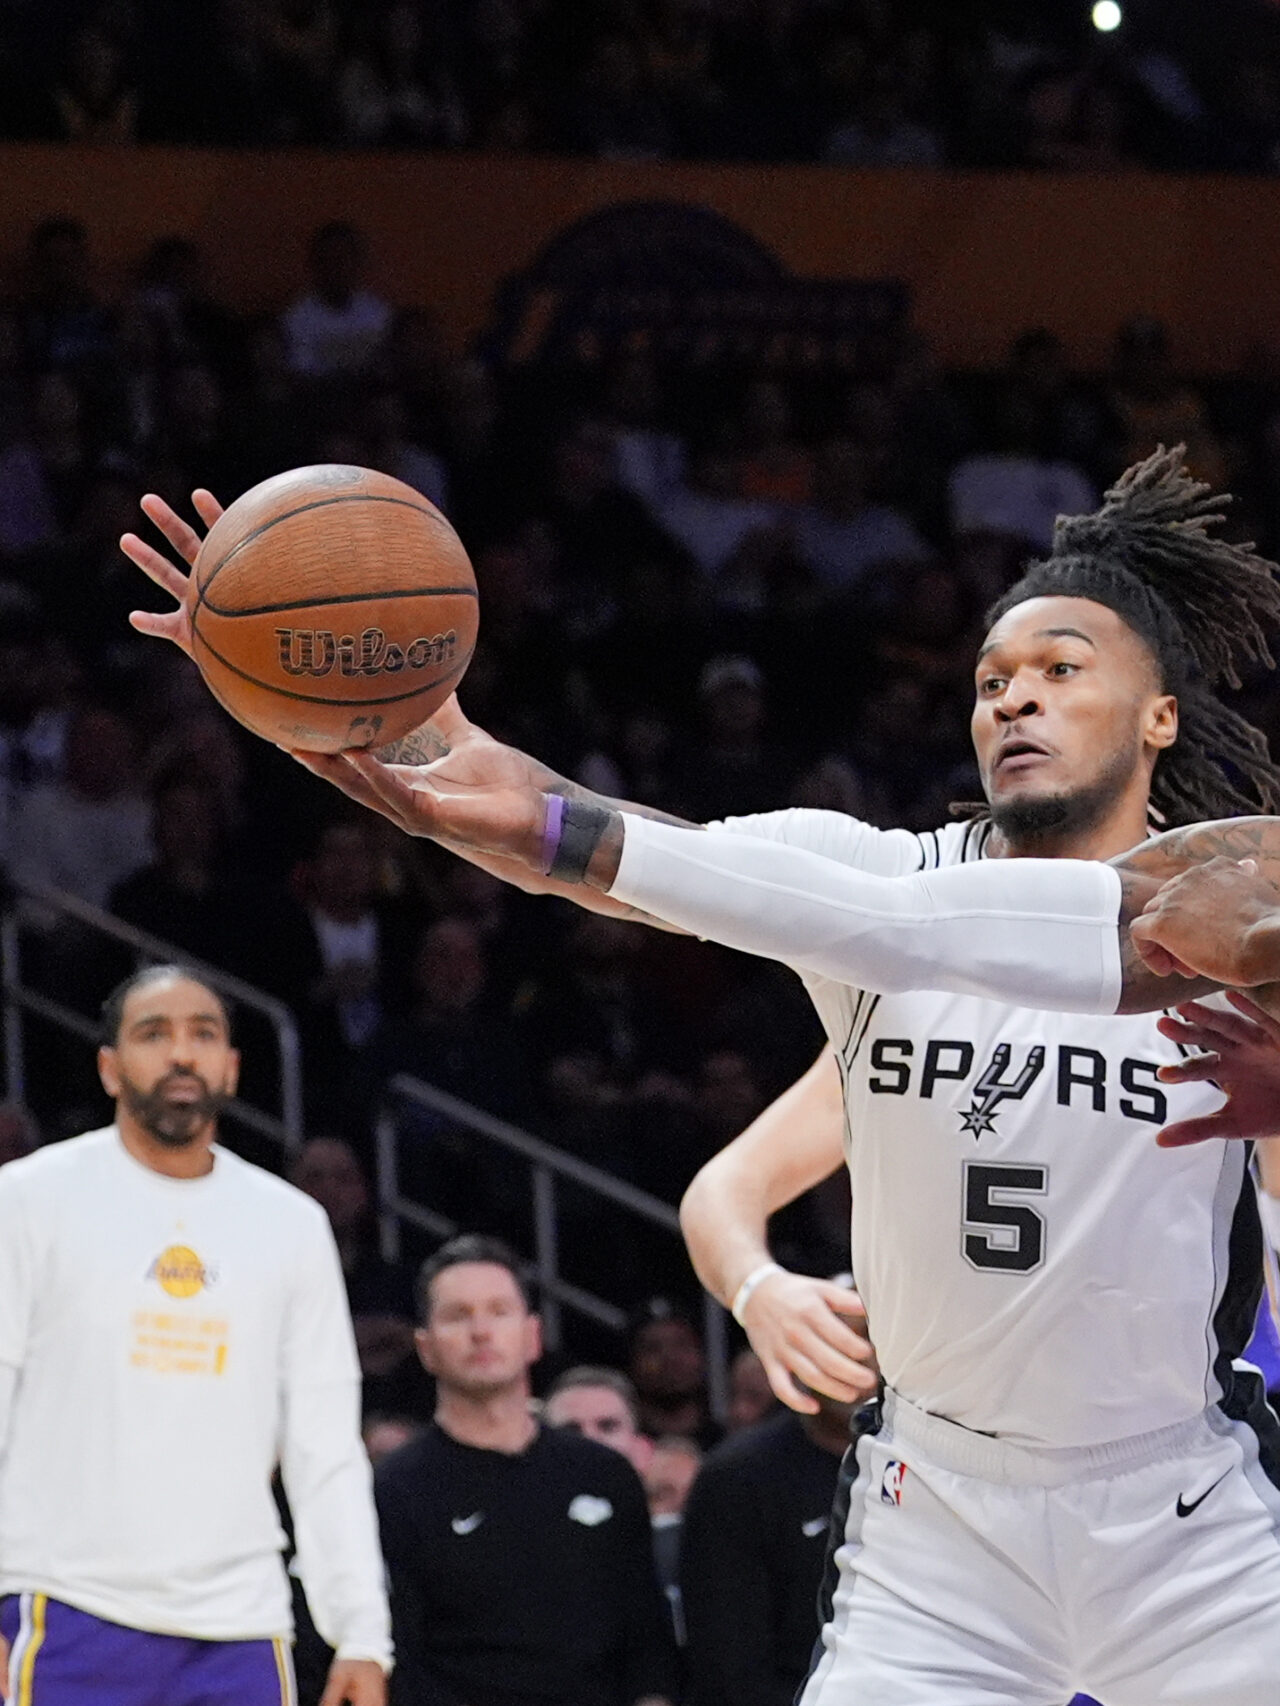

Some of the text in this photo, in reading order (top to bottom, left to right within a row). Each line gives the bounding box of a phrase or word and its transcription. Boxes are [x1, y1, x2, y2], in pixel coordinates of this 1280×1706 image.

[275, 627, 456, 678] Wilson
[868, 1038, 1168, 1141] SPURS
[960, 1159, 1050, 1275] 5
